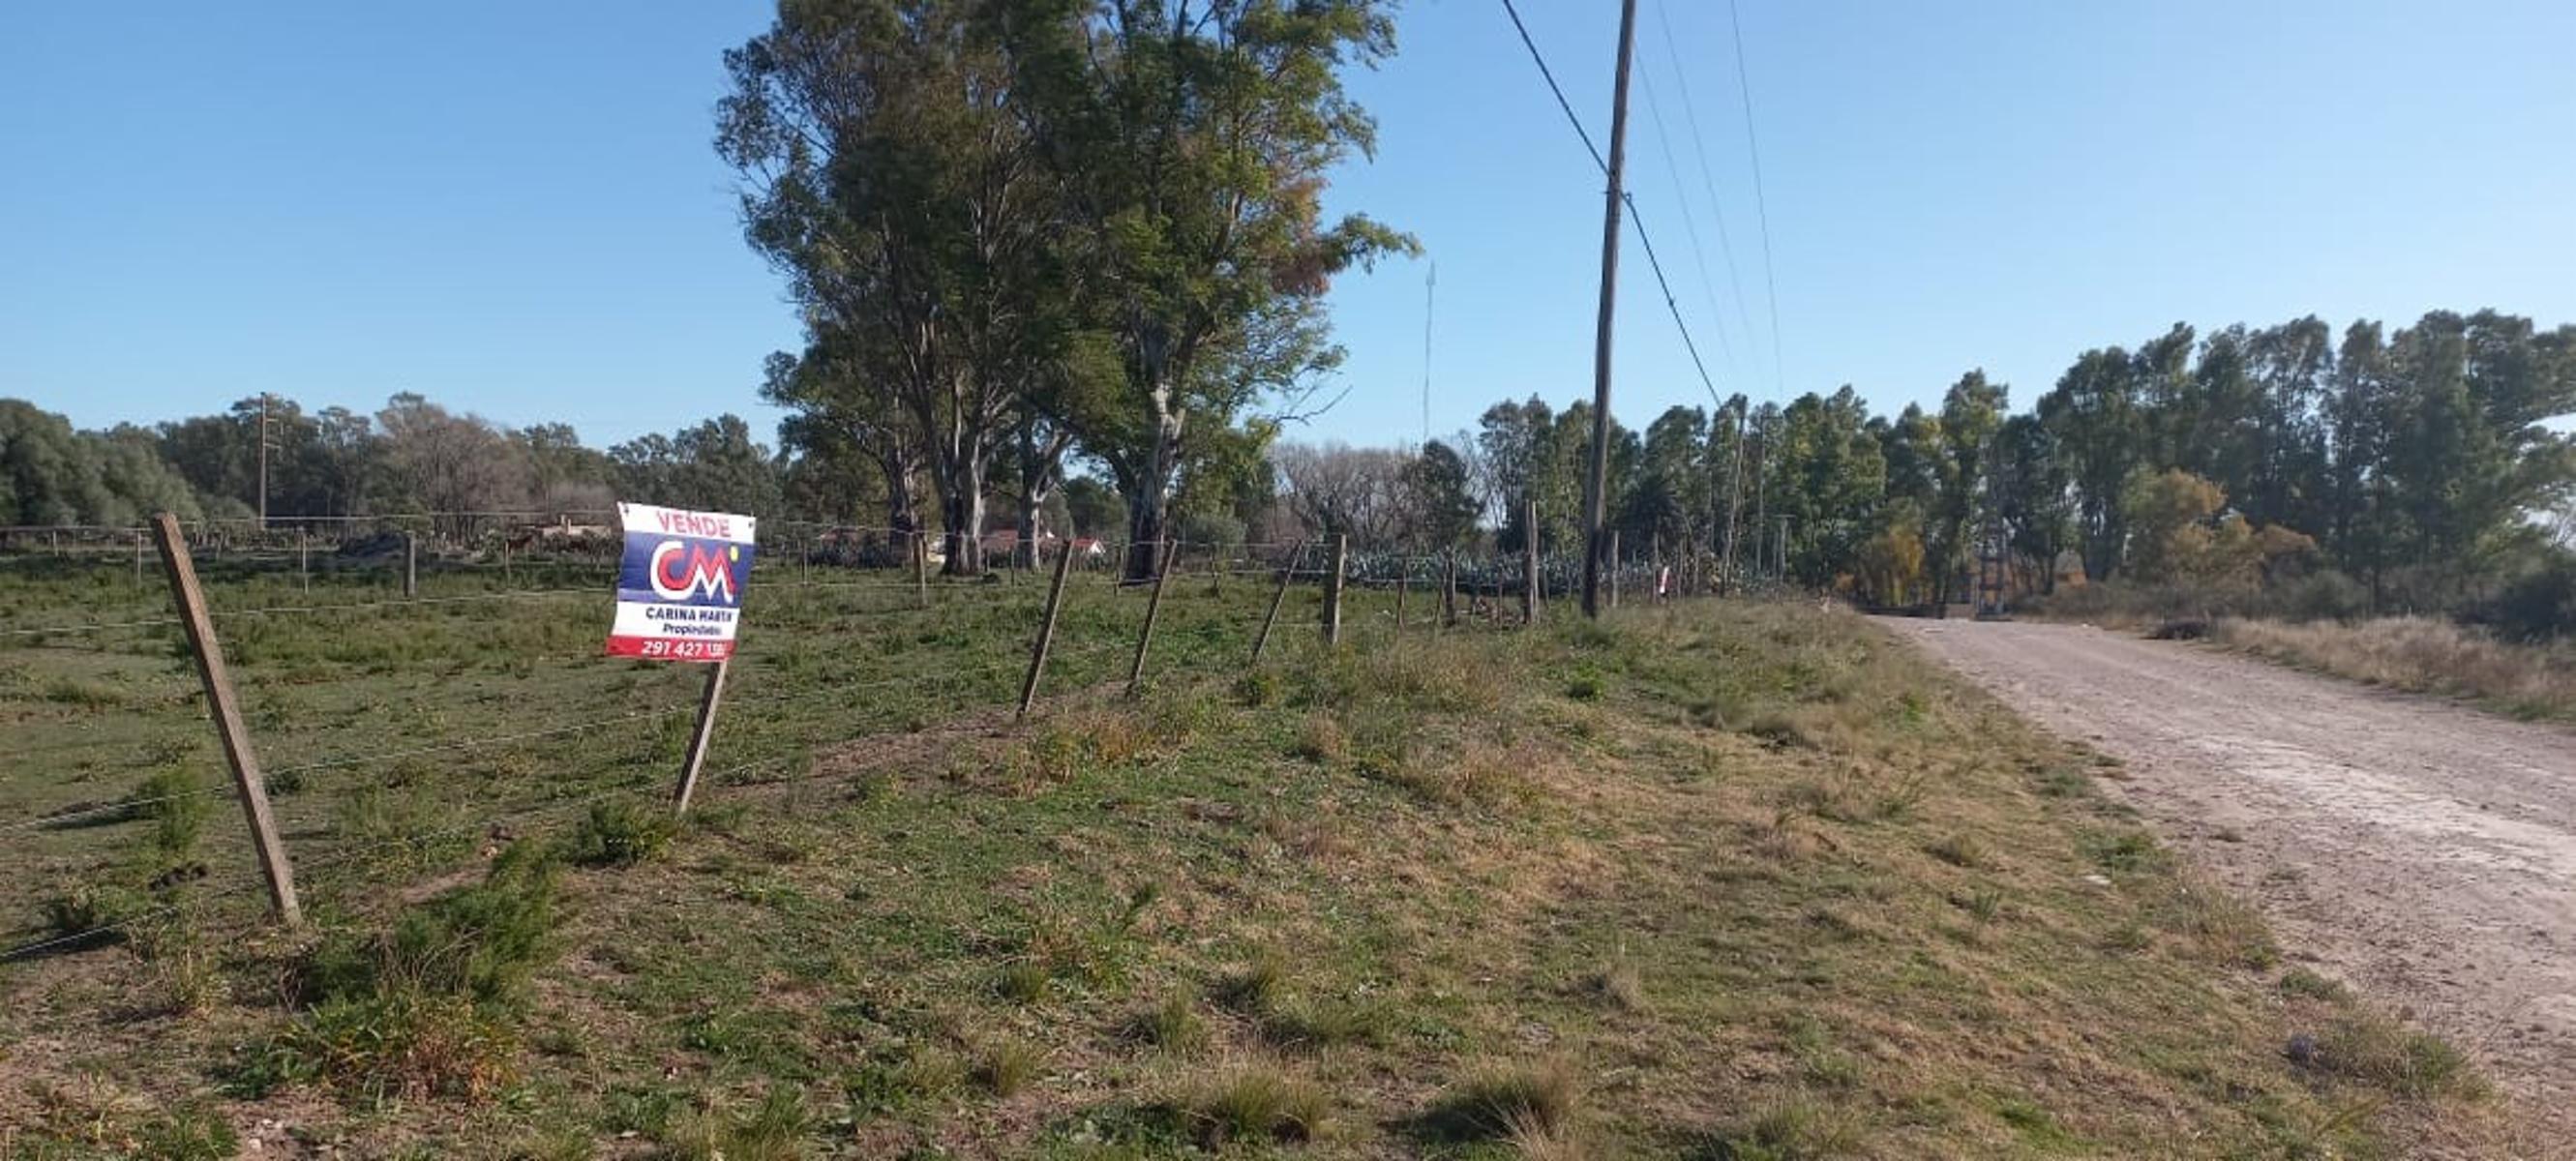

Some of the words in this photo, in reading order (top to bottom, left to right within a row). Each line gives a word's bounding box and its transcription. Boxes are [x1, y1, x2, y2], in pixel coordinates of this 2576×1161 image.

[656, 510, 732, 538] VENDE
[649, 540, 736, 604] CM
[645, 607, 696, 621] CARINA
[641, 641, 670, 656] 291
[673, 642, 704, 658] 427
